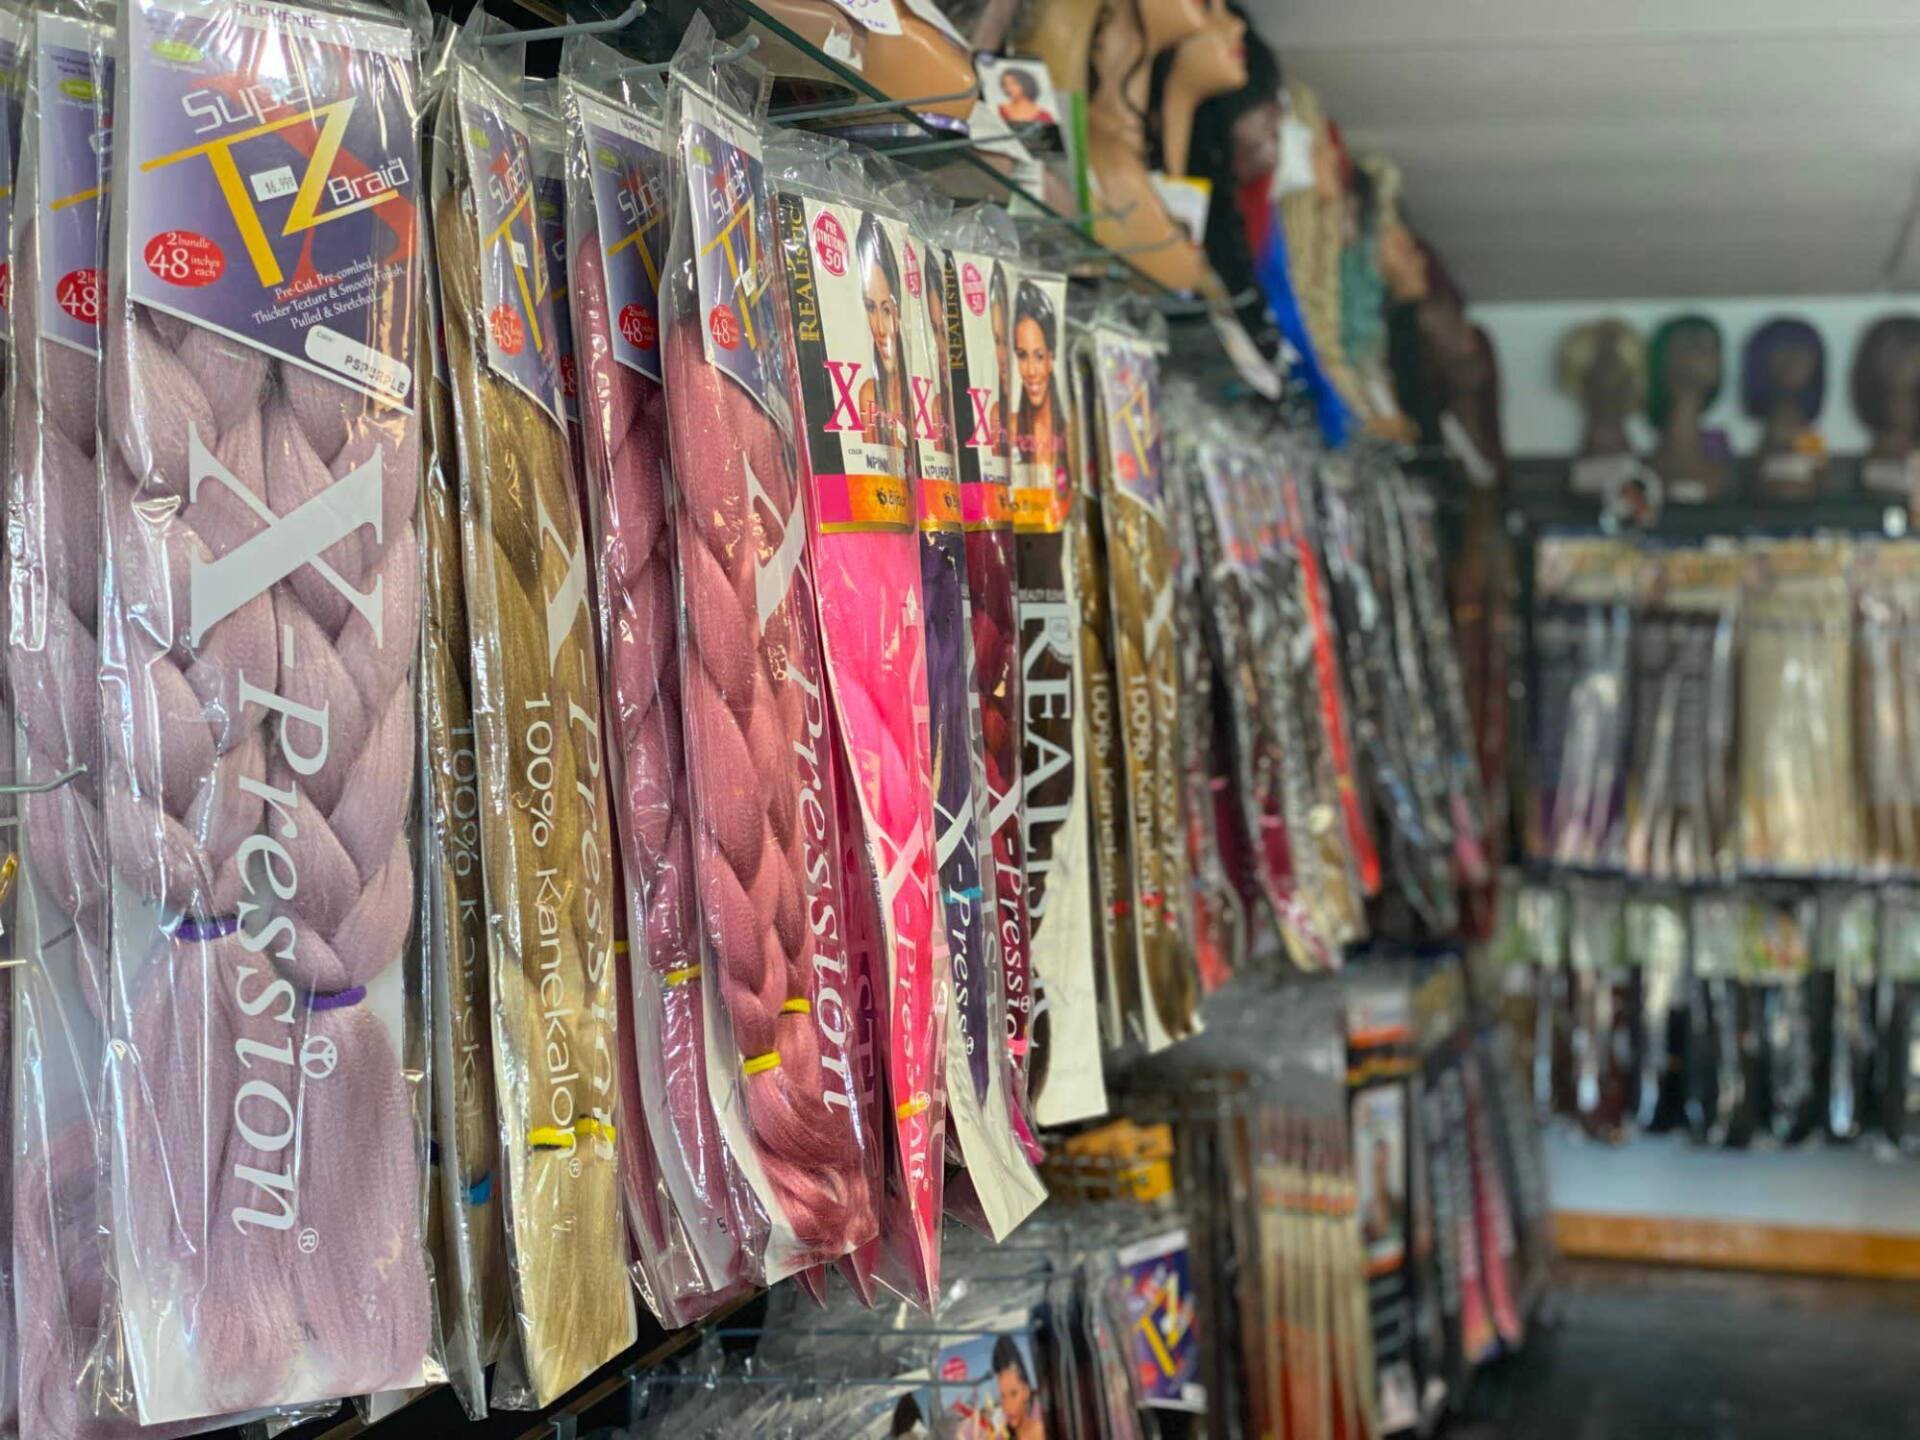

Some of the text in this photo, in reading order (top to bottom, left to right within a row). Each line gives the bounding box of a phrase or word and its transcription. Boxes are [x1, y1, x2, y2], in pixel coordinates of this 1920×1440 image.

[328, 157, 410, 206] Braid
[166, 232, 177, 245] 2
[149, 244, 190, 279] 48
[60, 284, 98, 318] 48
[252, 304, 292, 325] Thicker
[290, 290, 328, 312] Texture
[290, 306, 323, 330] Pulled
[622, 317, 644, 343] 48
[712, 317, 730, 343] 48
[525, 692, 580, 1160] 100% Kanekalon
